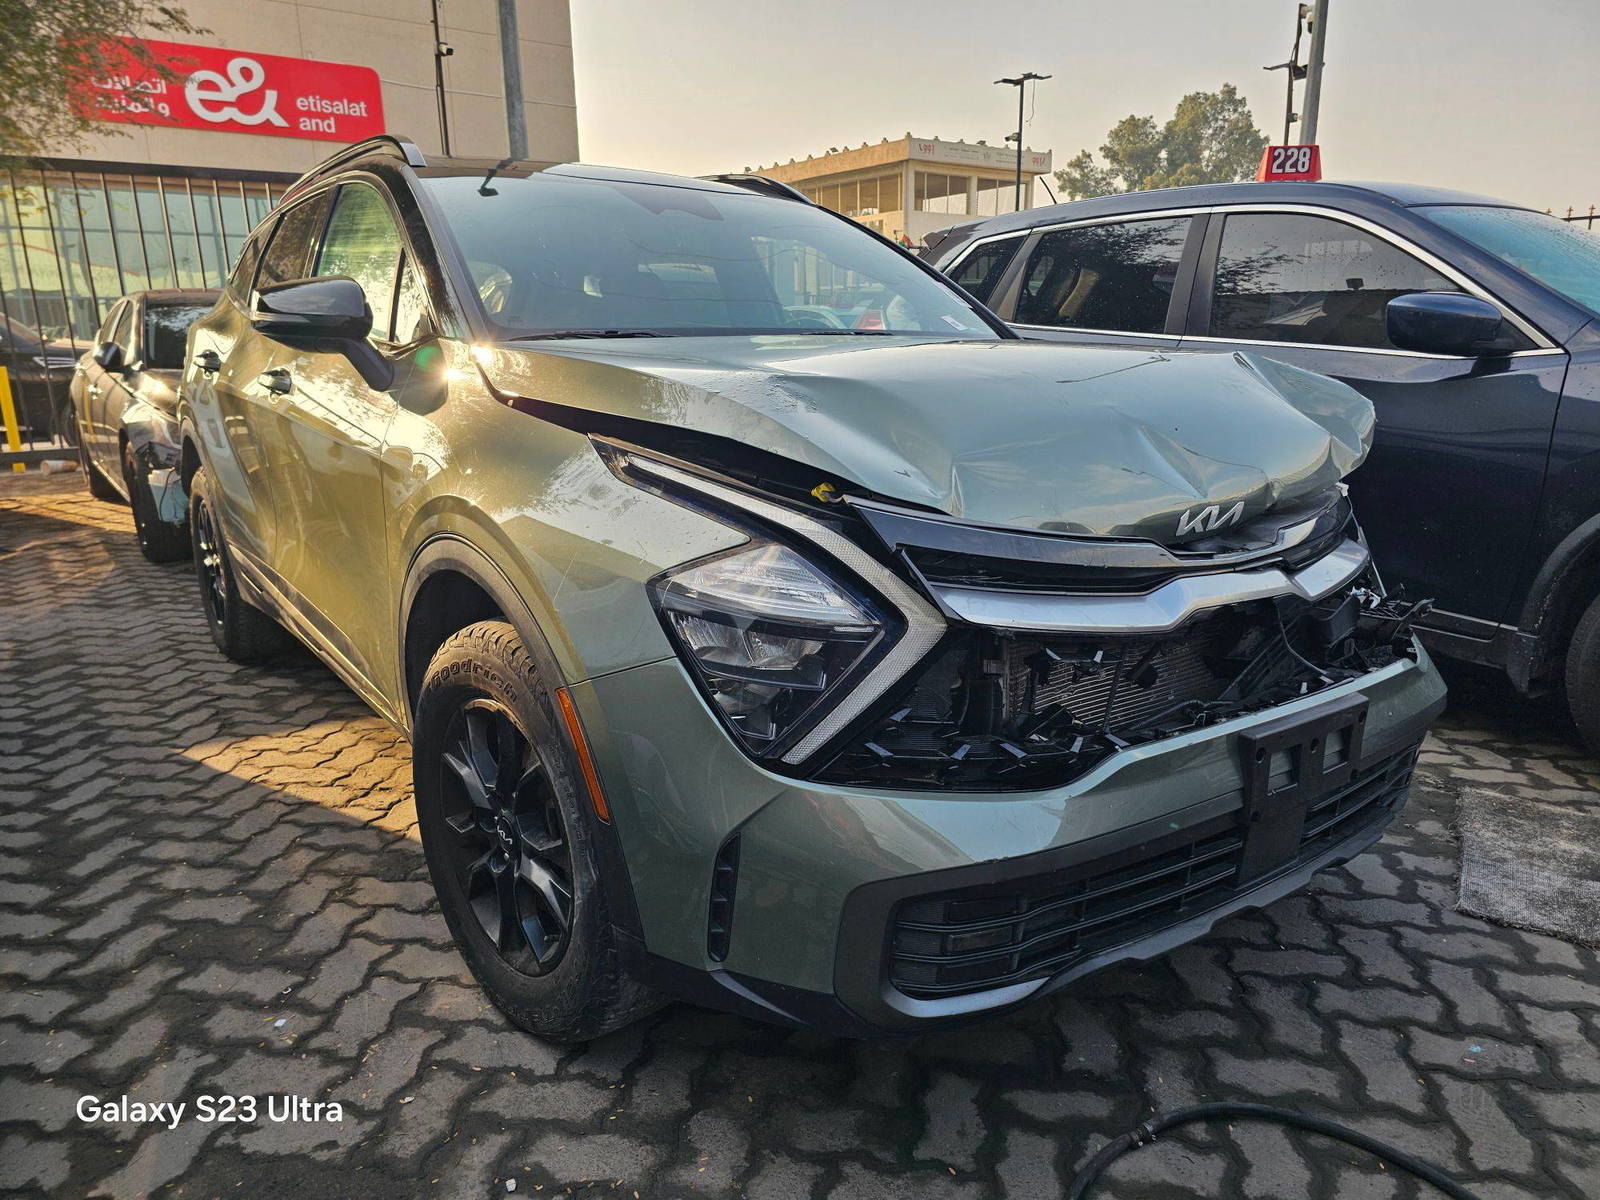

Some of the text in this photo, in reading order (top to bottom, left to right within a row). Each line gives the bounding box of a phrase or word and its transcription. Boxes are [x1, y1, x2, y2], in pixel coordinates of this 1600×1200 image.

[296, 95, 368, 117] etisalat
[299, 115, 336, 133] and
[1271, 147, 1311, 173] 228
